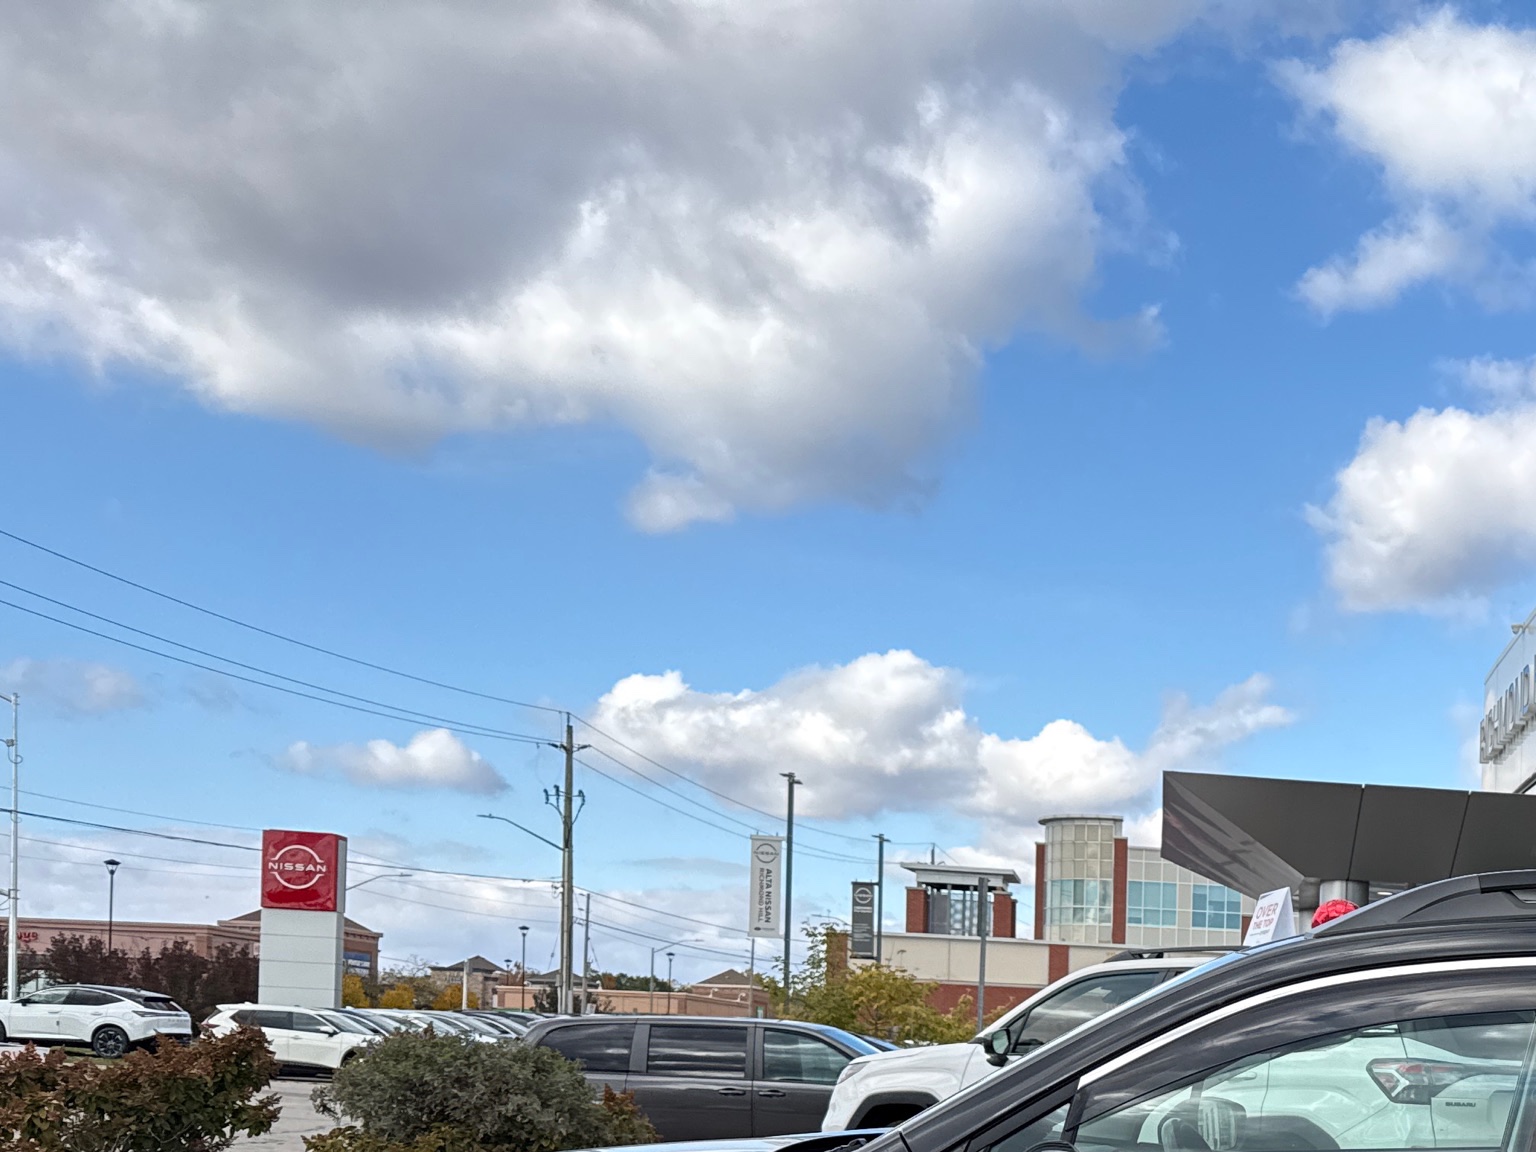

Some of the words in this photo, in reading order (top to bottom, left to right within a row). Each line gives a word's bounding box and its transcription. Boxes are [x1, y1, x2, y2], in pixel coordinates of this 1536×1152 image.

[268, 861, 327, 873] NISSAN
[765, 868, 773, 891] ALTA
[764, 892, 773, 924] NISSAN
[1256, 902, 1279, 919] OVER
